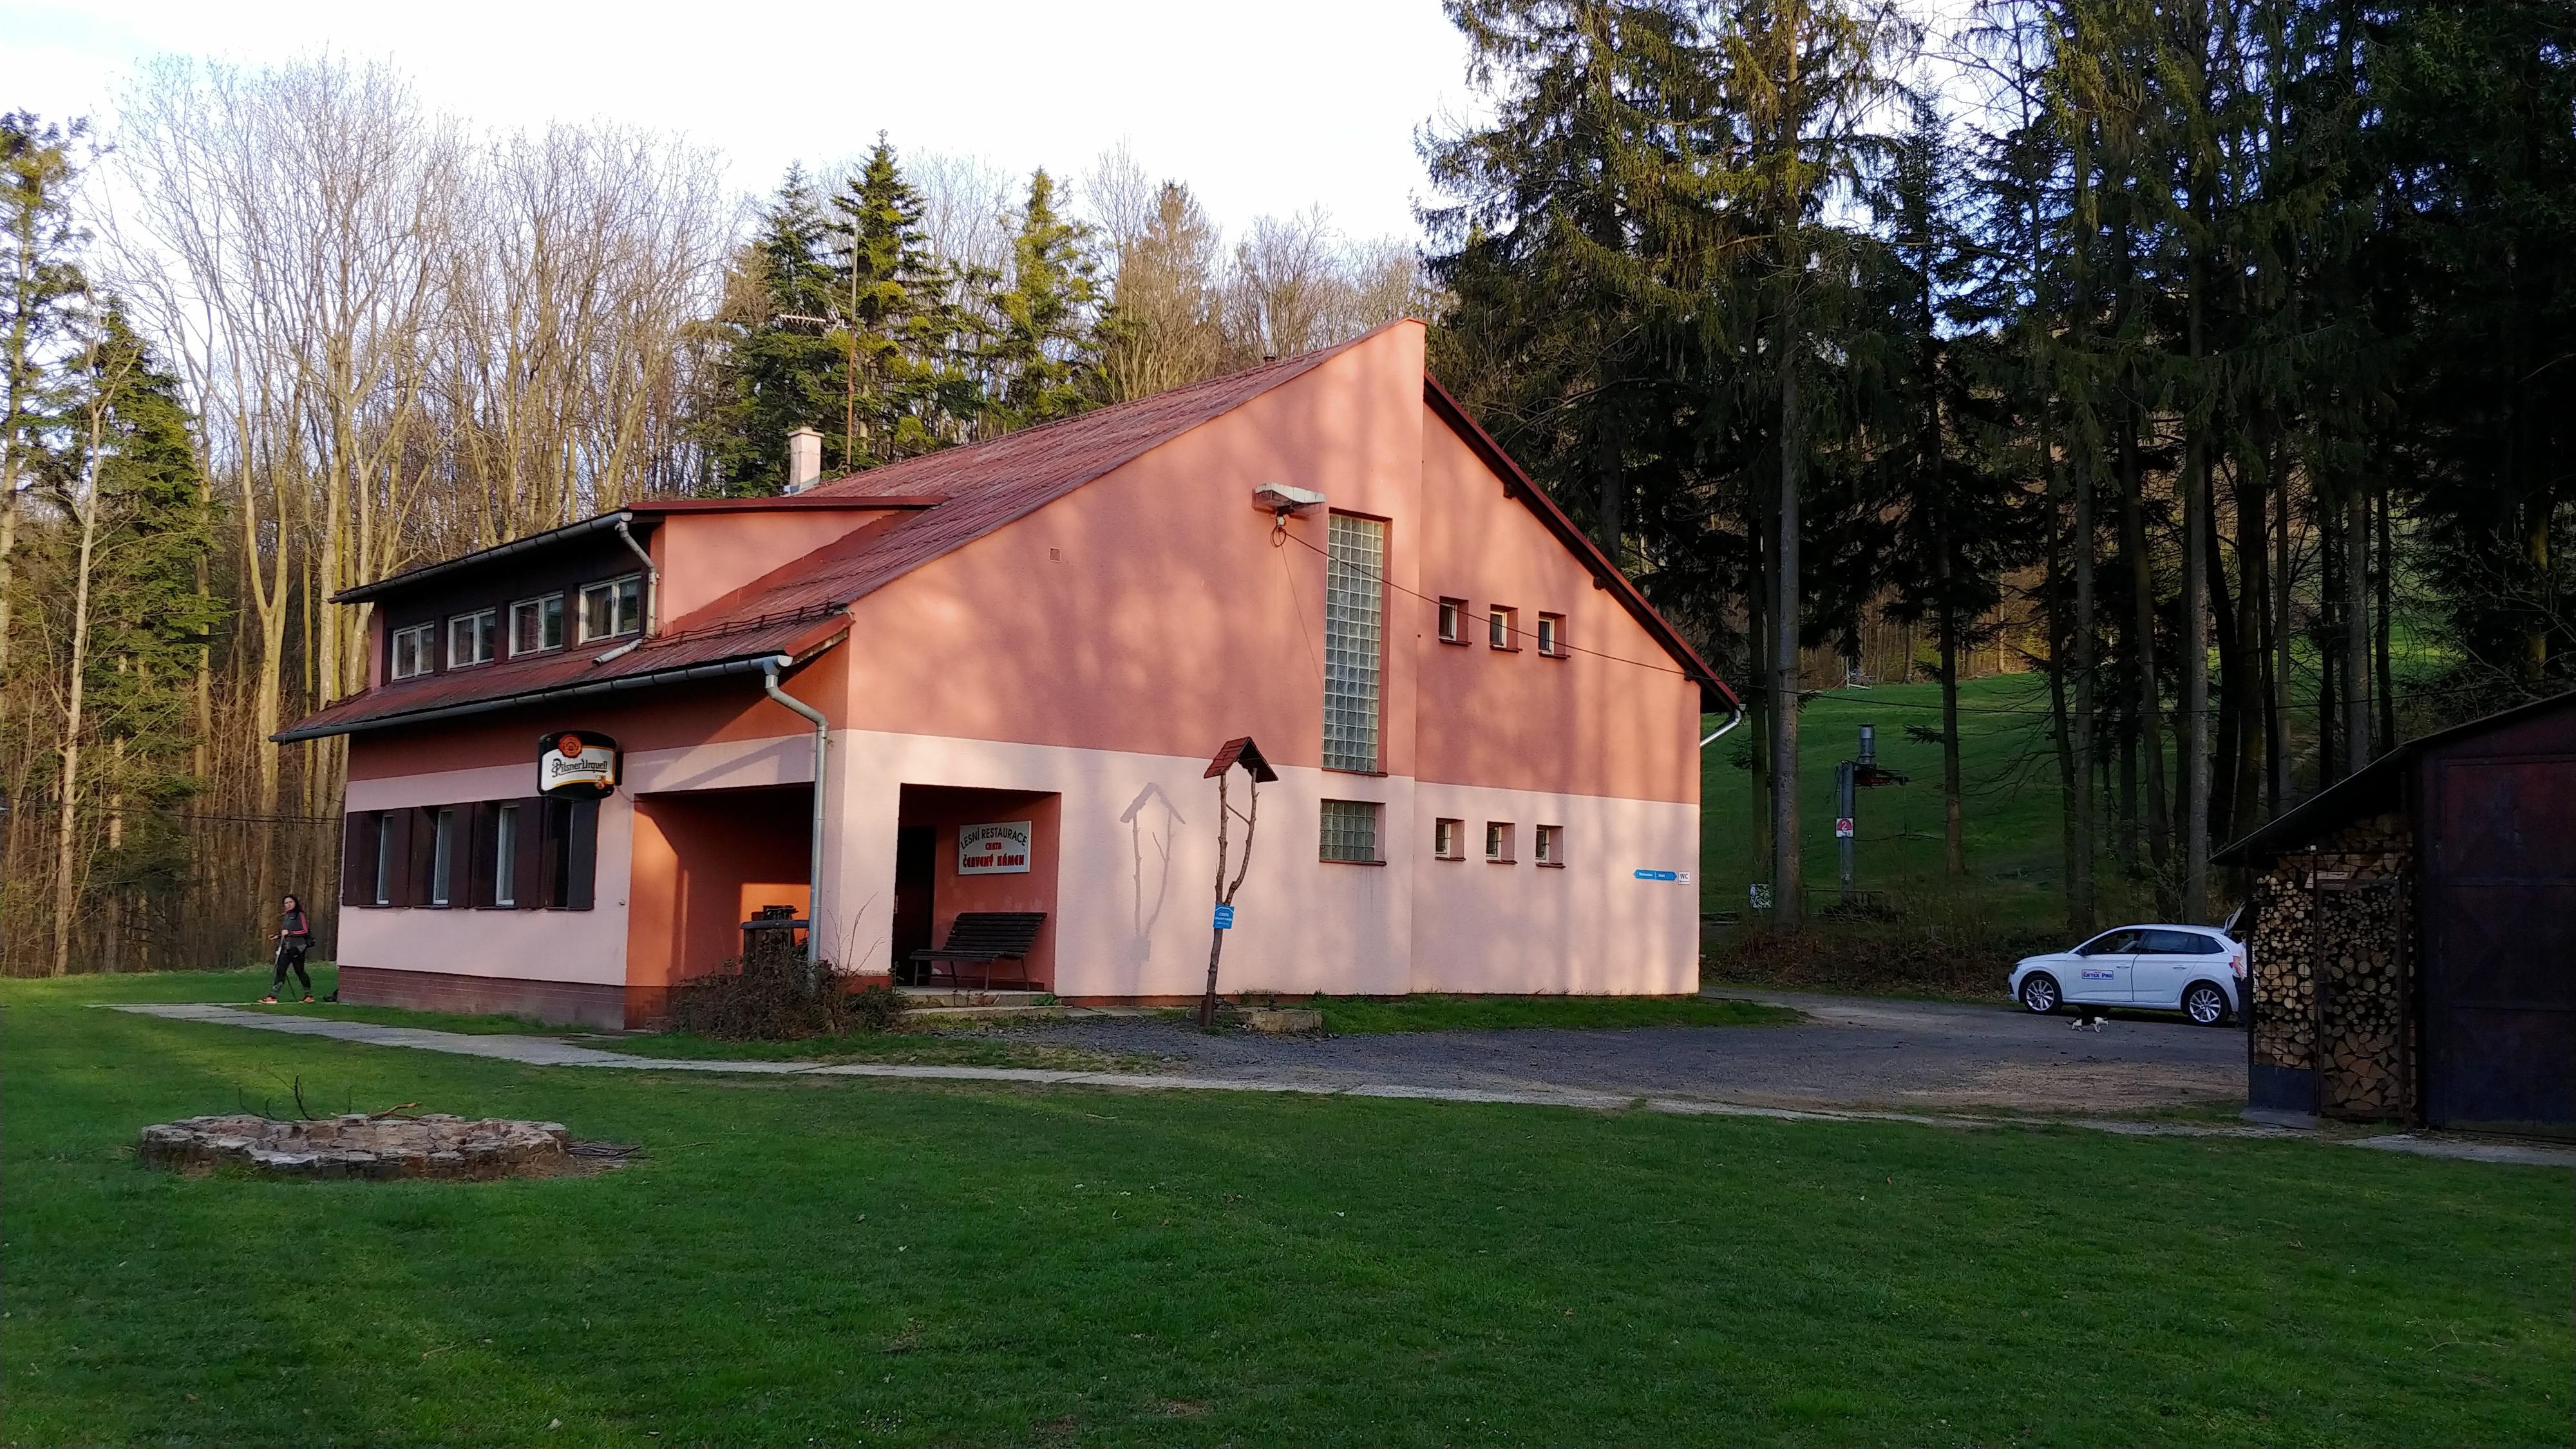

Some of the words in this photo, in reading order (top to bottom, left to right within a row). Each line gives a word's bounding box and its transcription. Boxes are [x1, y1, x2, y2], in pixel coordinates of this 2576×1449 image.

[552, 758, 582, 777] Pilsner
[582, 758, 608, 773] Urquell
[1841, 820, 1848, 830] 2
[961, 828, 980, 850] LESNÍ
[981, 827, 1028, 847] RESTAURACE
[985, 842, 1002, 850] CHATA
[963, 853, 994, 868] ČERVENÝ
[997, 853, 1025, 866] KÁMEN
